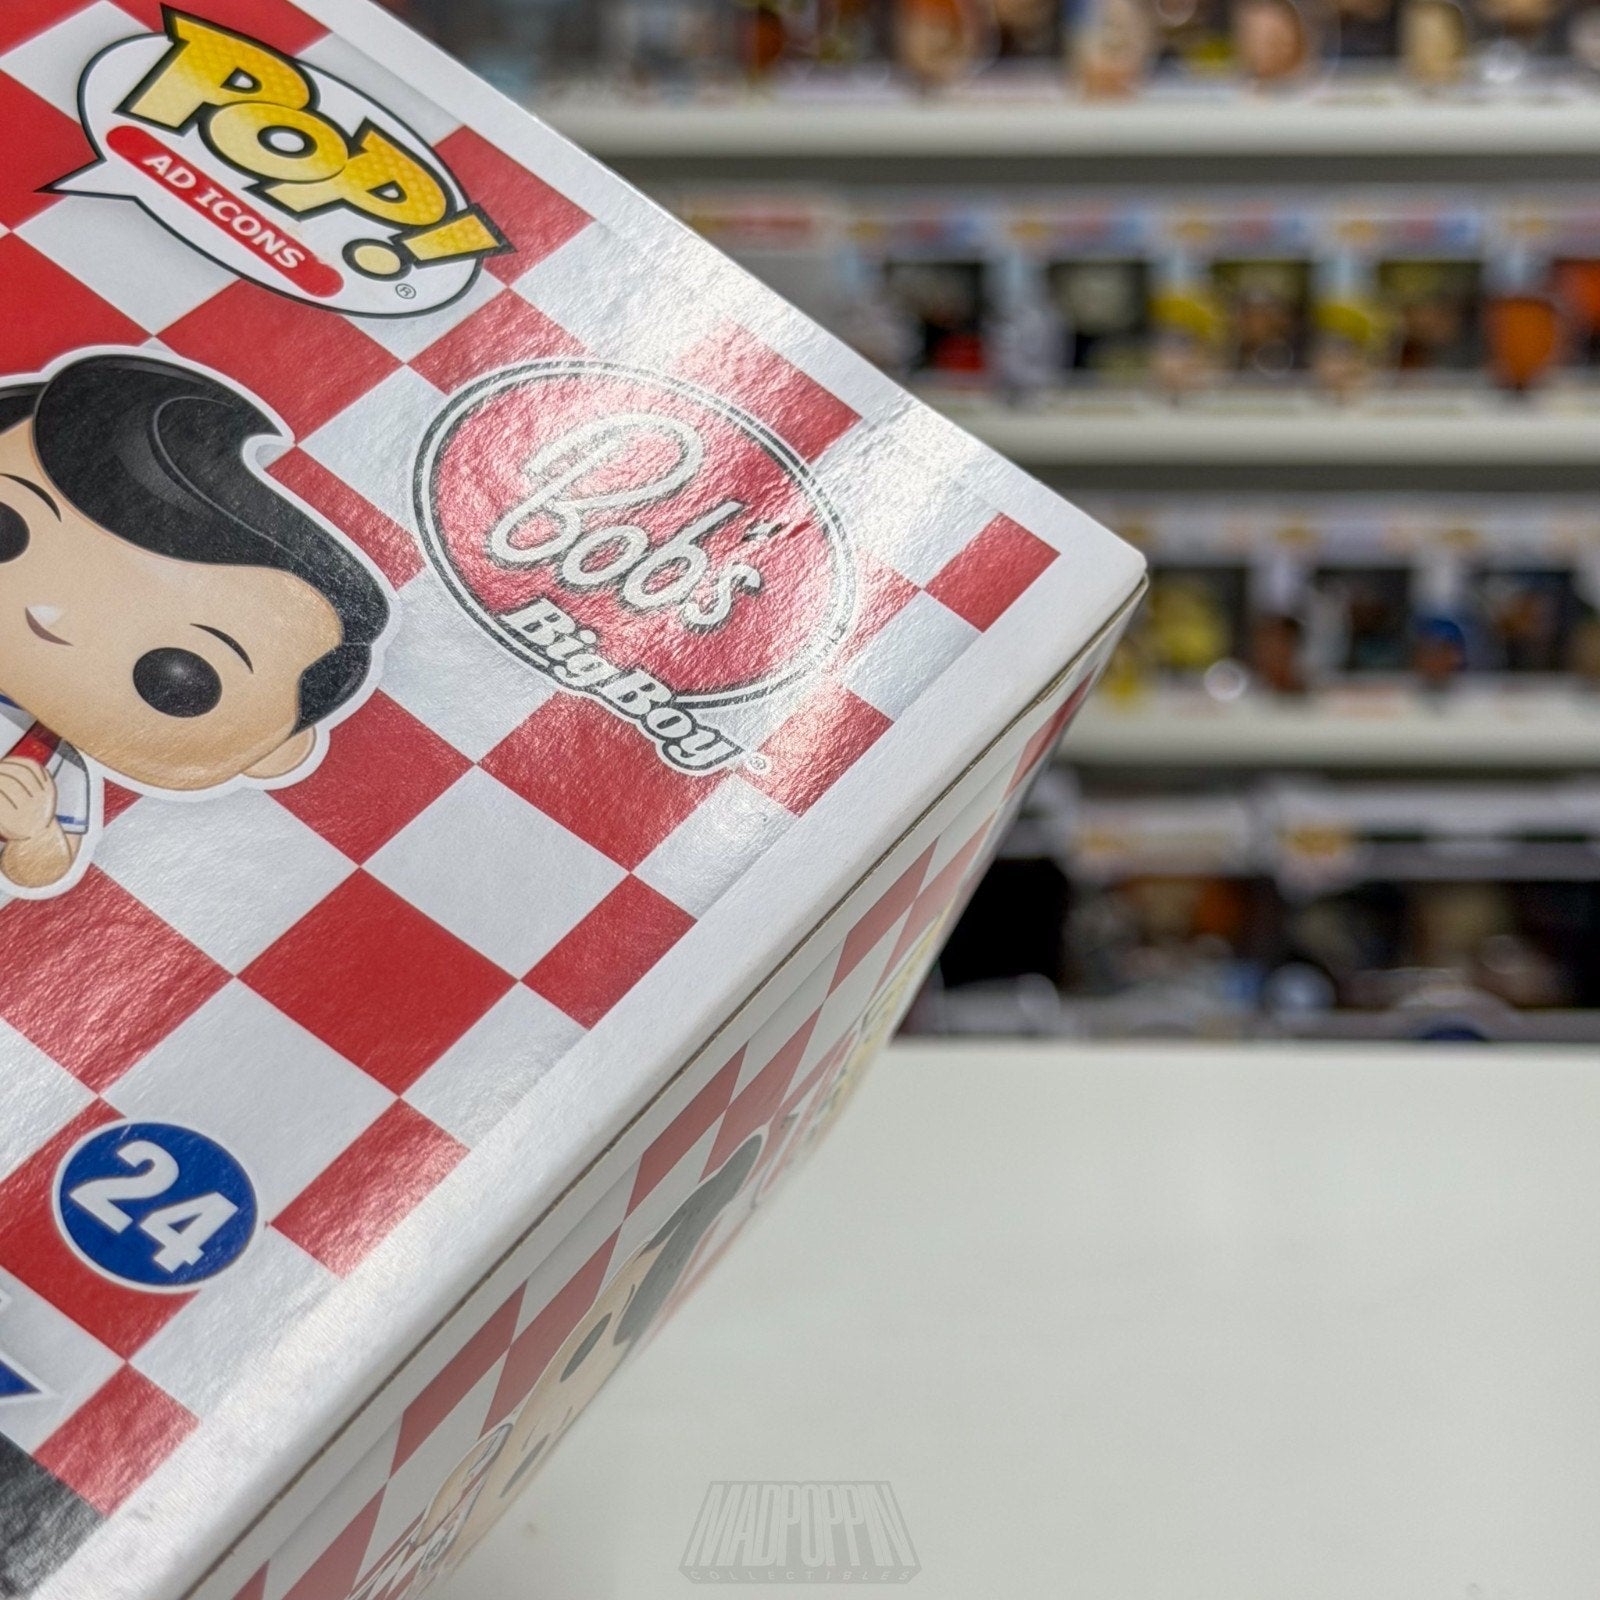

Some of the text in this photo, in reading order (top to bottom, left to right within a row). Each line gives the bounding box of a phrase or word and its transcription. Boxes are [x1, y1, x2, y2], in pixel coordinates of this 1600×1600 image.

[115, 3, 516, 282] POP!
[142, 154, 308, 271] AD ICONS
[489, 412, 784, 633] Bob's
[69, 1140, 240, 1273] 24
